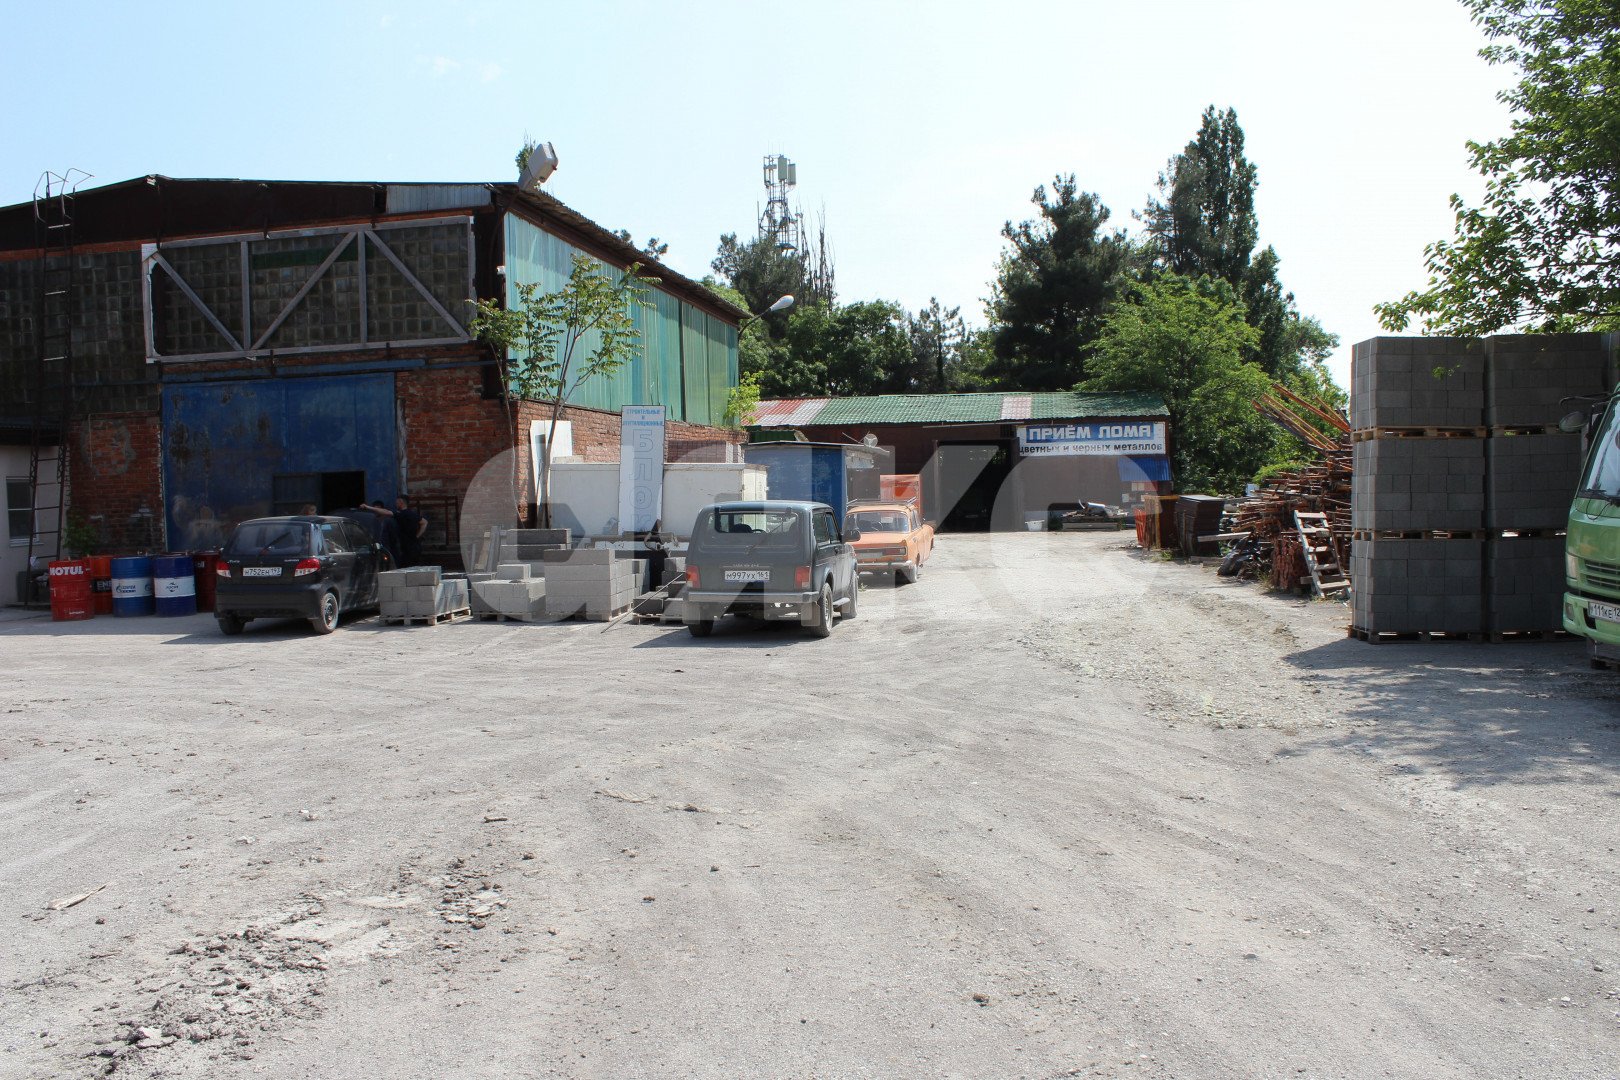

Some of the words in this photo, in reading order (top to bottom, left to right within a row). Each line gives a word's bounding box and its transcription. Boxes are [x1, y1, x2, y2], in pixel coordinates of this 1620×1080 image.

[1028, 424, 1092, 441] ПРИЁМ
[1098, 424, 1151, 439] ЛОМА
[1019, 445, 1061, 454] цветных
[1113, 442, 1163, 452] металлов
[49, 566, 84, 576] MOTUL
